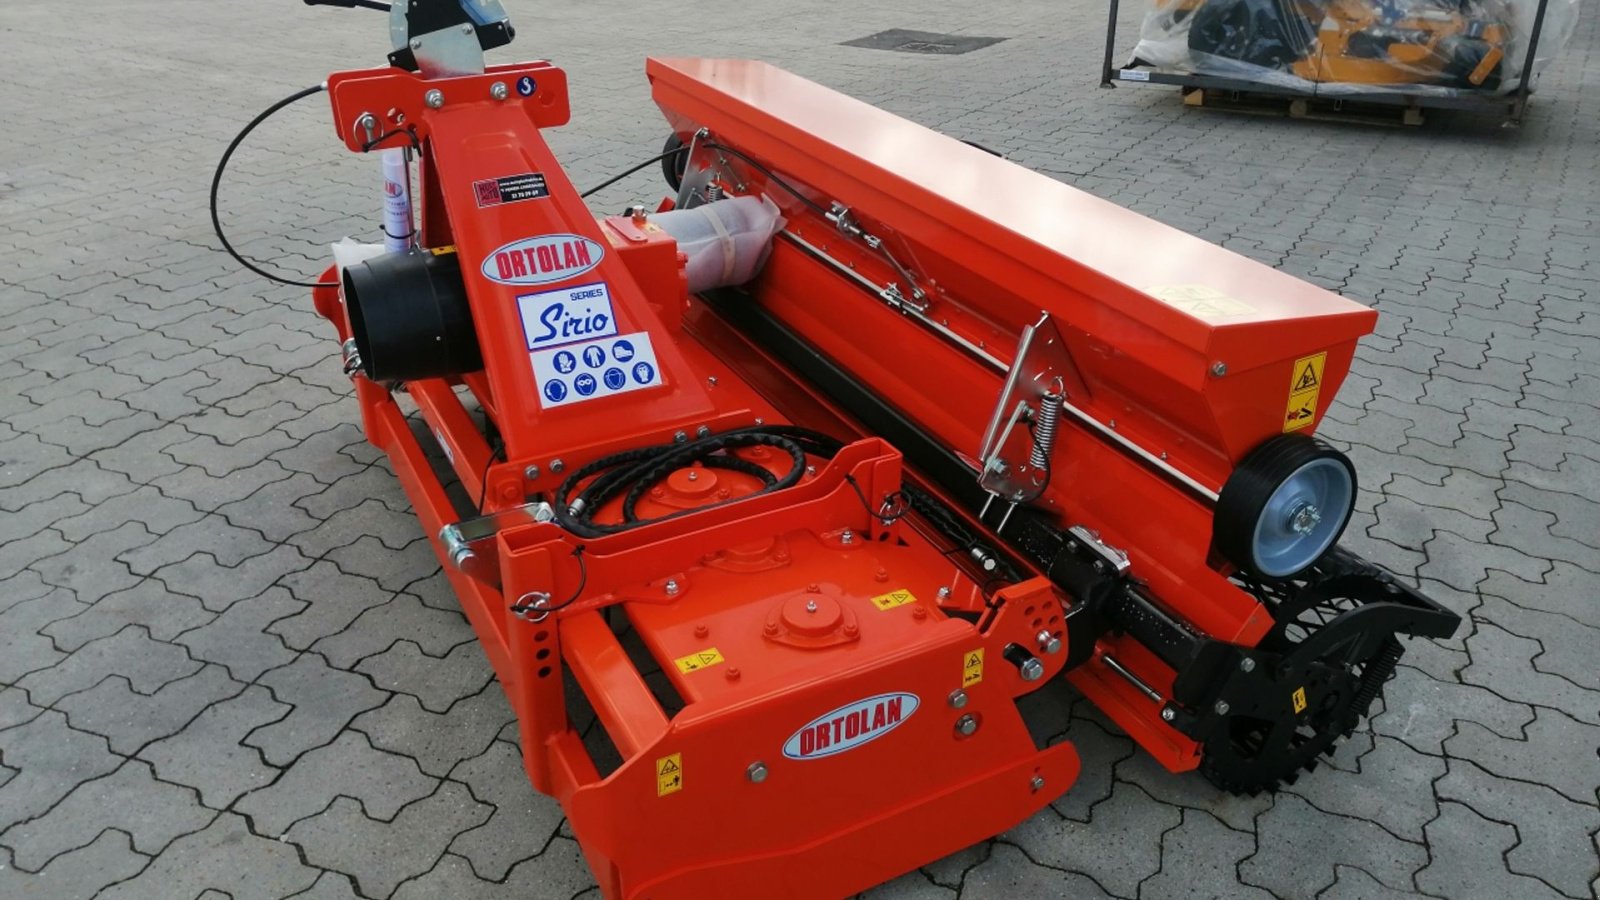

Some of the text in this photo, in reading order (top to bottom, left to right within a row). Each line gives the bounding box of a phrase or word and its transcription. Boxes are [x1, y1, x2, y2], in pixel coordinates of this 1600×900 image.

[495, 240, 592, 280] ORTOLAN
[570, 288, 604, 301] SERIES
[532, 302, 609, 343] Sirio
[800, 696, 903, 756] ORTOLAN
